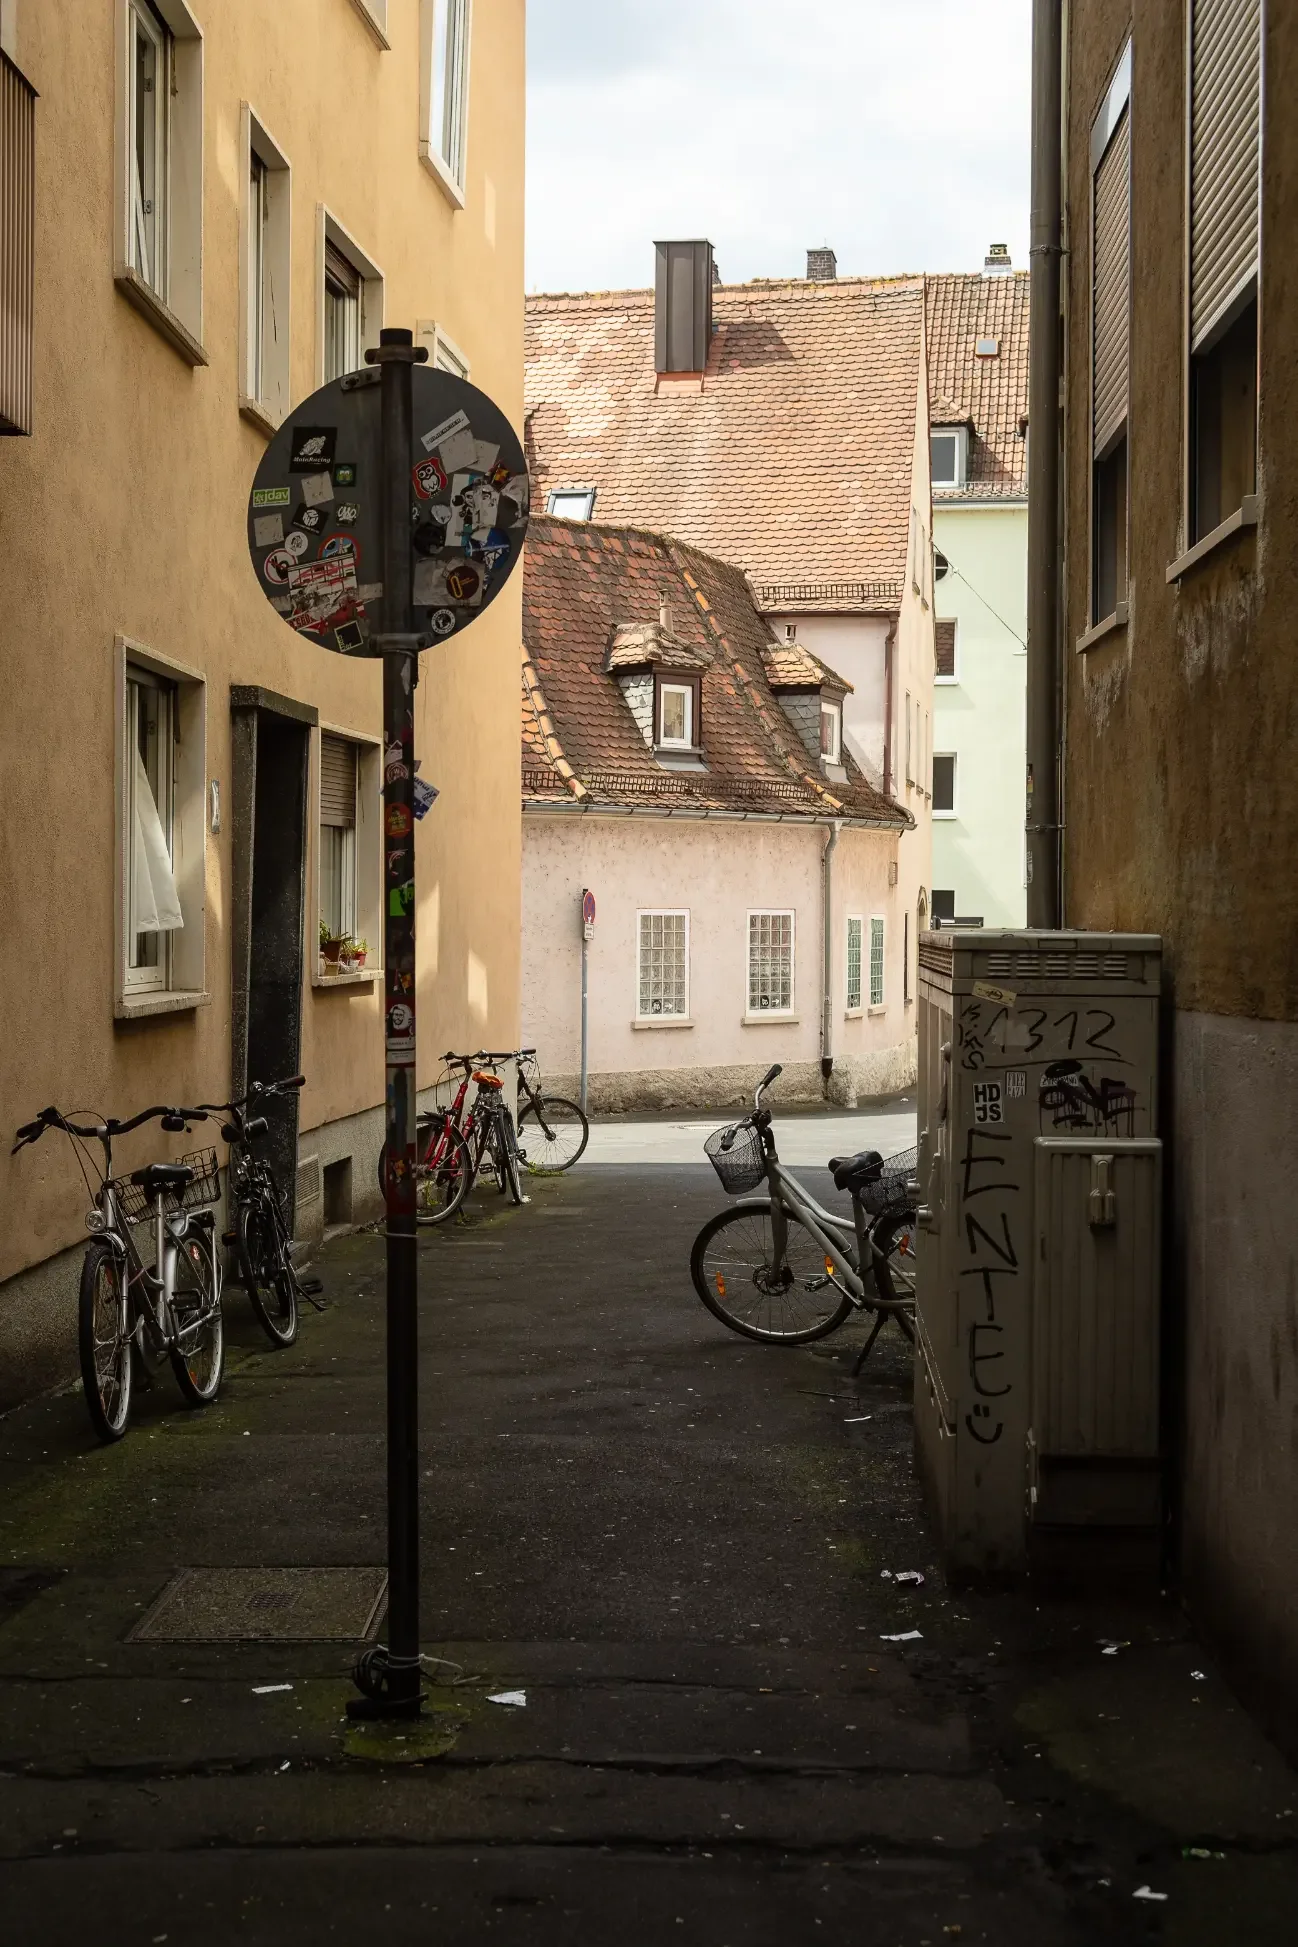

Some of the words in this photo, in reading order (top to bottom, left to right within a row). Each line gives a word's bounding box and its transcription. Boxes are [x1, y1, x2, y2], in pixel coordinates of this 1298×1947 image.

[264, 488, 289, 503] jdav
[984, 1007, 1122, 1058] 1312
[974, 1083, 1001, 1103] HD
[975, 1103, 1001, 1122] JS
[961, 1127, 1021, 1398] ENTE
